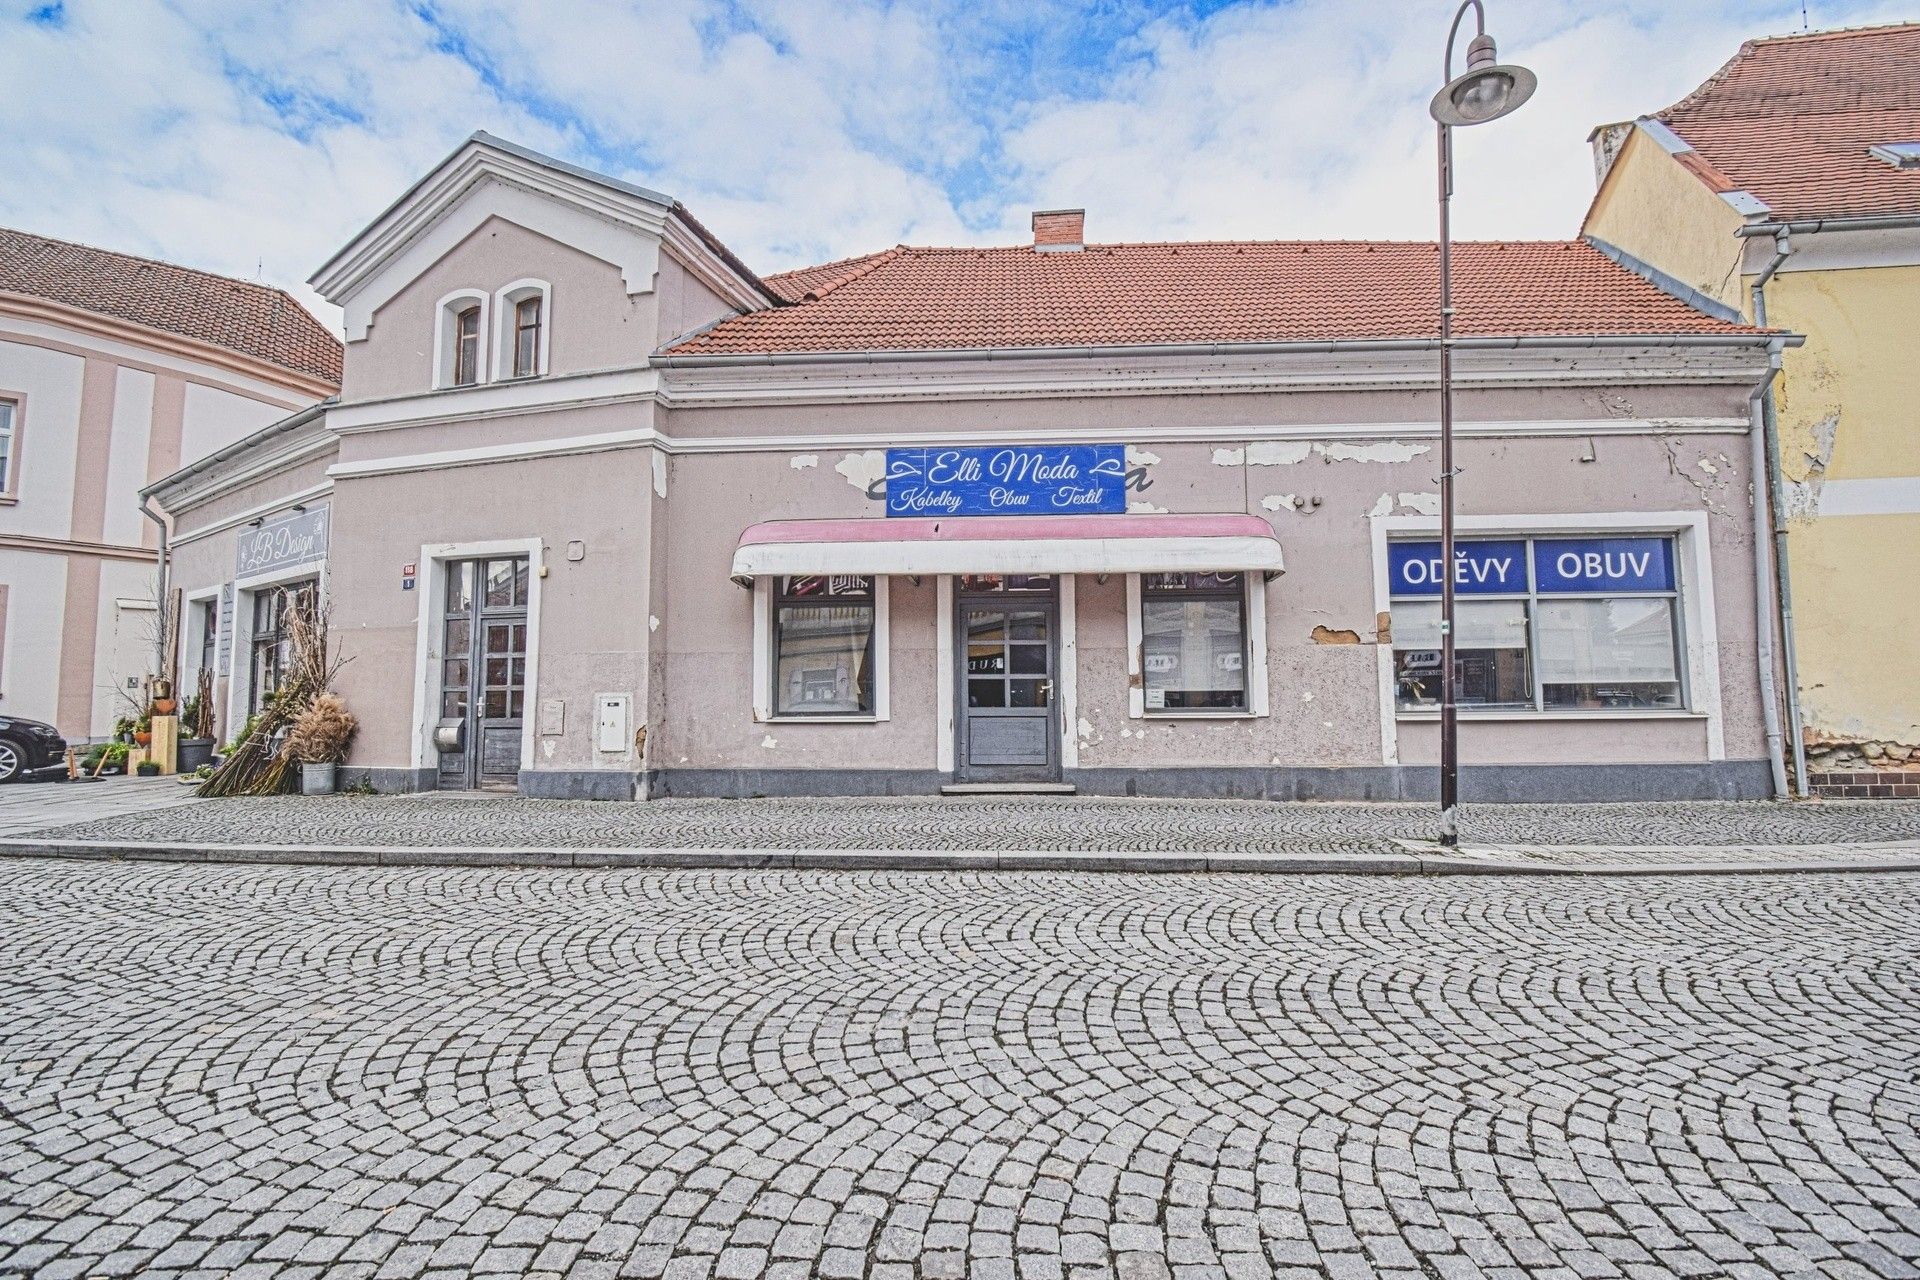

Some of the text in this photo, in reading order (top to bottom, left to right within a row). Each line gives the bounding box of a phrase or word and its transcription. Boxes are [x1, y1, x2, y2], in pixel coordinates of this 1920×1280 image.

[928, 449, 1079, 484] Elli Moda
[890, 485, 962, 512] Kabelky
[989, 486, 1030, 507] Obuv
[1051, 485, 1102, 507] Textil
[274, 524, 314, 564] Design
[1403, 551, 1512, 584] ODĚVY
[1556, 552, 1650, 579] OBUV
